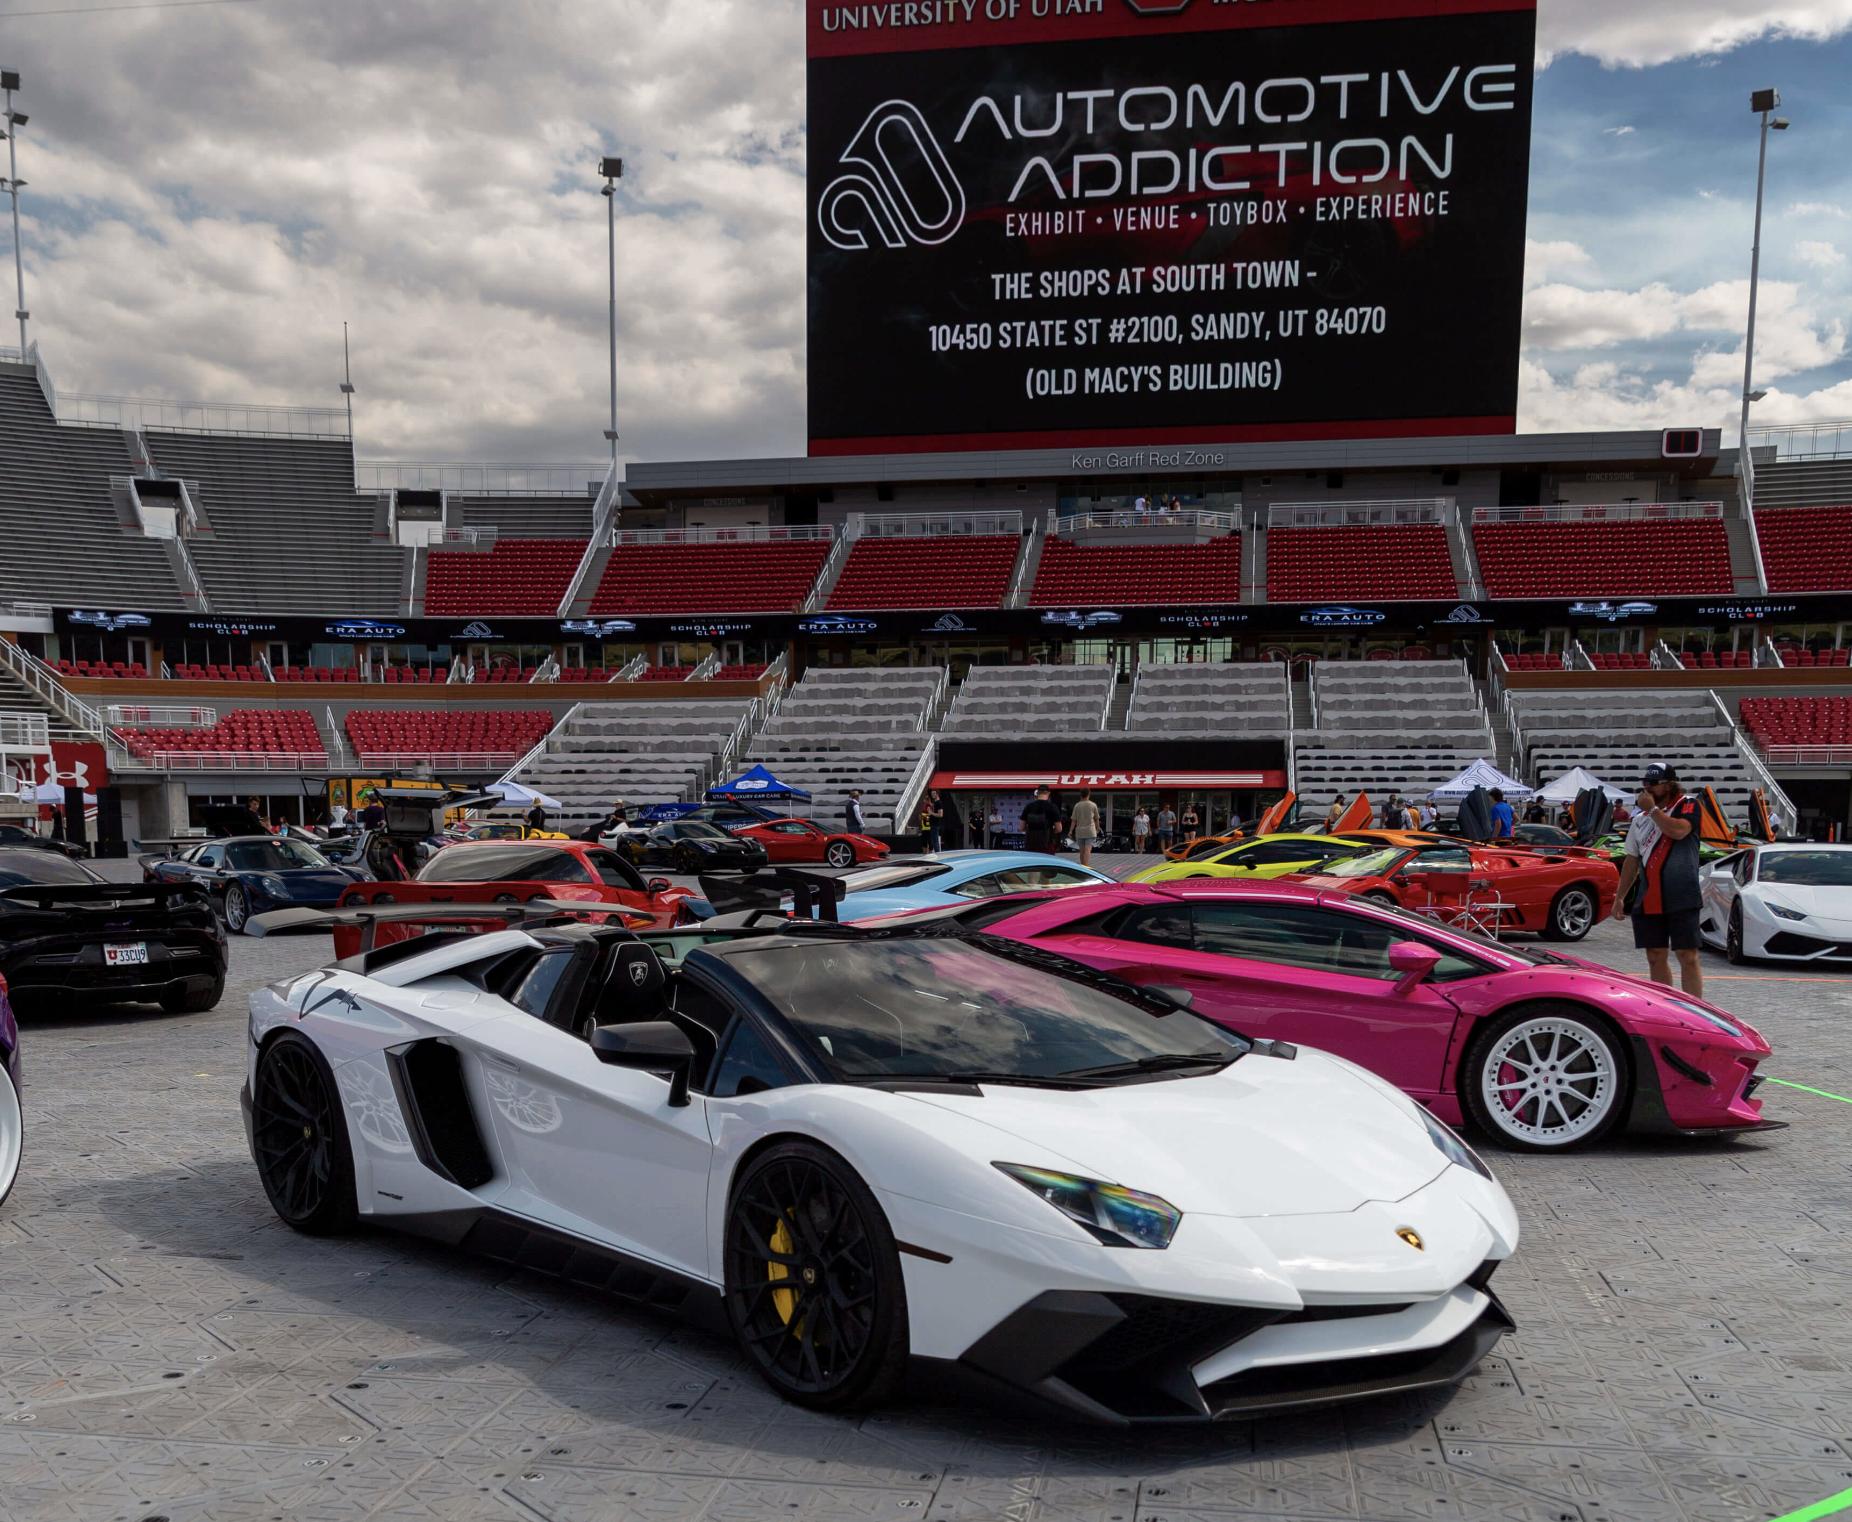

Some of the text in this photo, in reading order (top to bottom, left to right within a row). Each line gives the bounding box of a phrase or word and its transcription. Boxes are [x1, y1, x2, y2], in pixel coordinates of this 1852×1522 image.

[823, 0, 1103, 31] UNIVERSITY OF UTAH
[954, 64, 1516, 143] AUTOMOTIVE
[1007, 134, 1453, 203] ADDICTION
[1006, 191, 1449, 237] EXHIBIT VENUE TOYBOX EXPERIENCE
[991, 273, 1033, 300] THE
[1039, 269, 1111, 298] SHOPS
[1117, 267, 1146, 294] AT
[1152, 264, 1225, 293] SOUTH
[1232, 260, 1299, 290] TOWN
[928, 306, 1386, 352] 10450 STATE ST #2100, SANDY, UT 84070
[1026, 359, 1283, 400] (OLD MACY'S BUILDING)
[1072, 451, 1224, 469] Ken Garff Red Zone
[1160, 615, 1248, 623] SCHOLARSHIP
[1698, 605, 1797, 614] SCHOLARSHIP
[188, 622, 277, 631] SCHOLARSHIP
[325, 626, 406, 634] ERA AUTO
[670, 623, 752, 631] SCHOLARSHIP
[1060, 774, 1155, 785] UTAH
